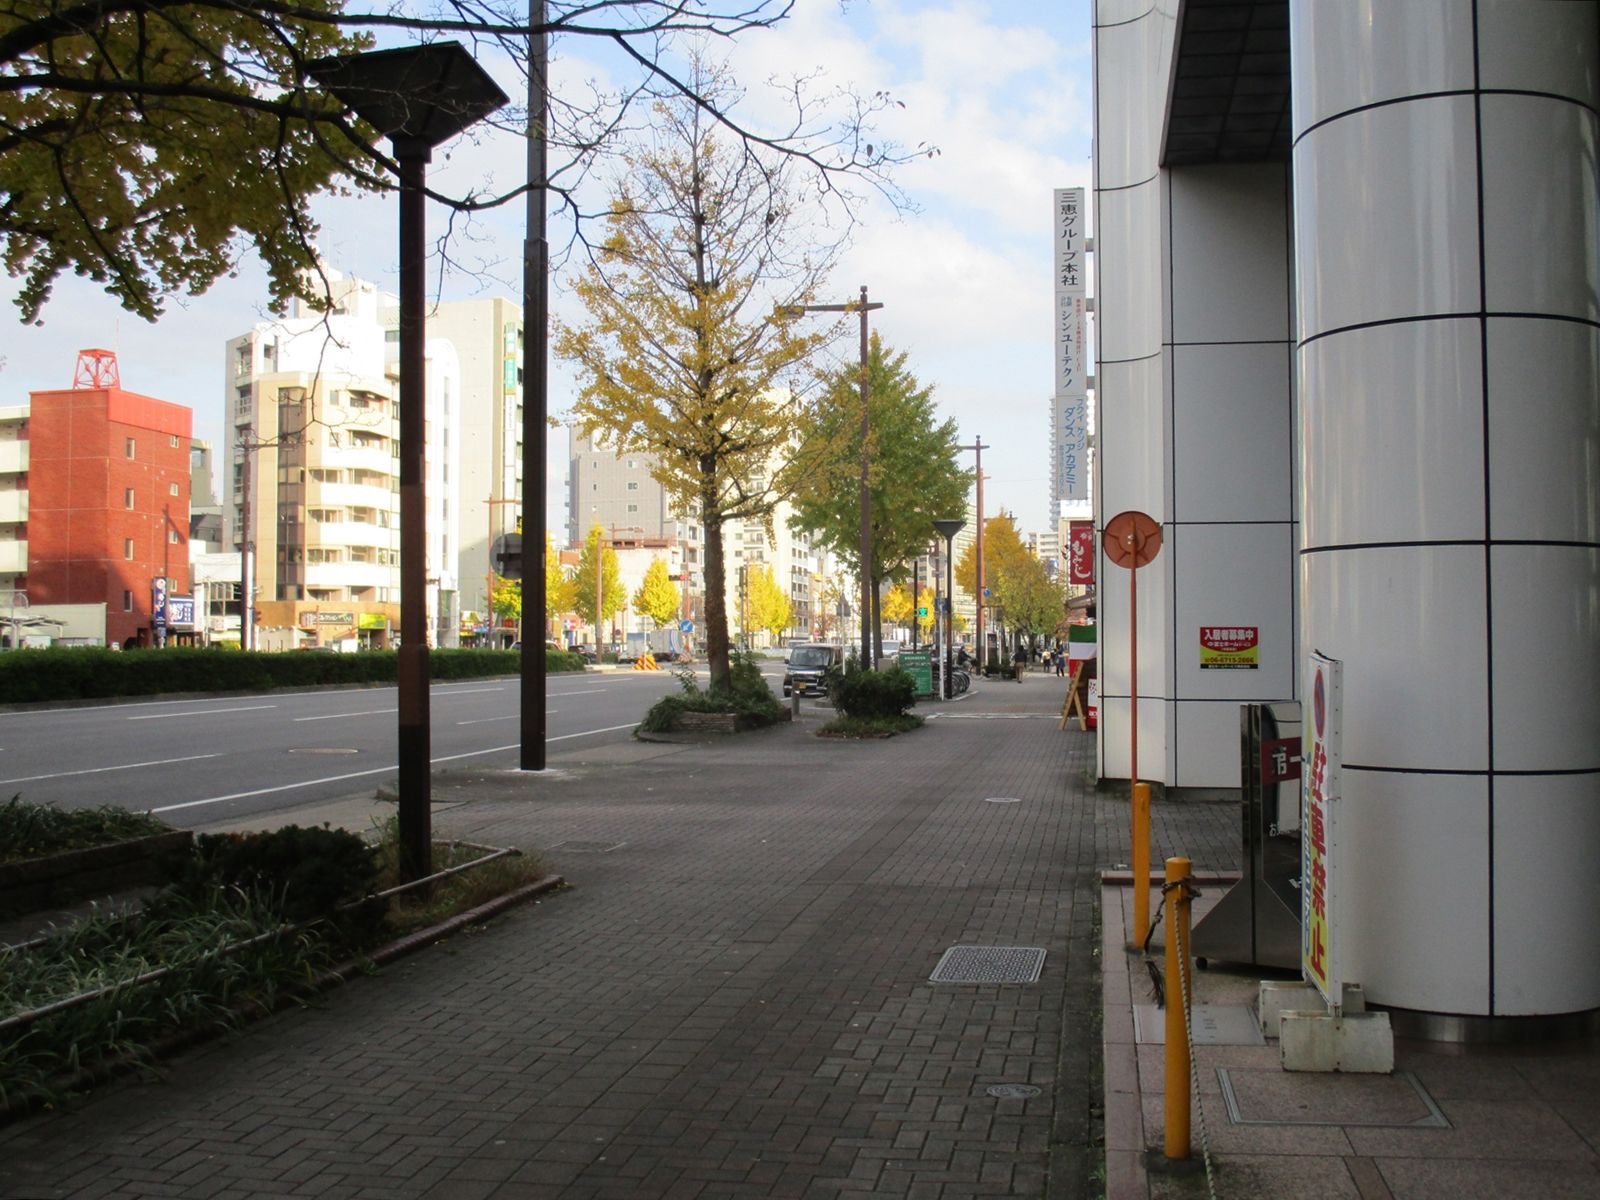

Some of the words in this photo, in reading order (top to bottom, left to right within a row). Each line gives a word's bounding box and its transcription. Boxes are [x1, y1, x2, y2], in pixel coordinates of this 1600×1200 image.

[1061, 192, 1078, 286] 三恵グループ本社
[1061, 310, 1073, 388] シンユーテクノ
[1064, 406, 1076, 438] ダンス
[1065, 443, 1076, 494] アカデミー
[1072, 540, 1091, 578] もみじ
